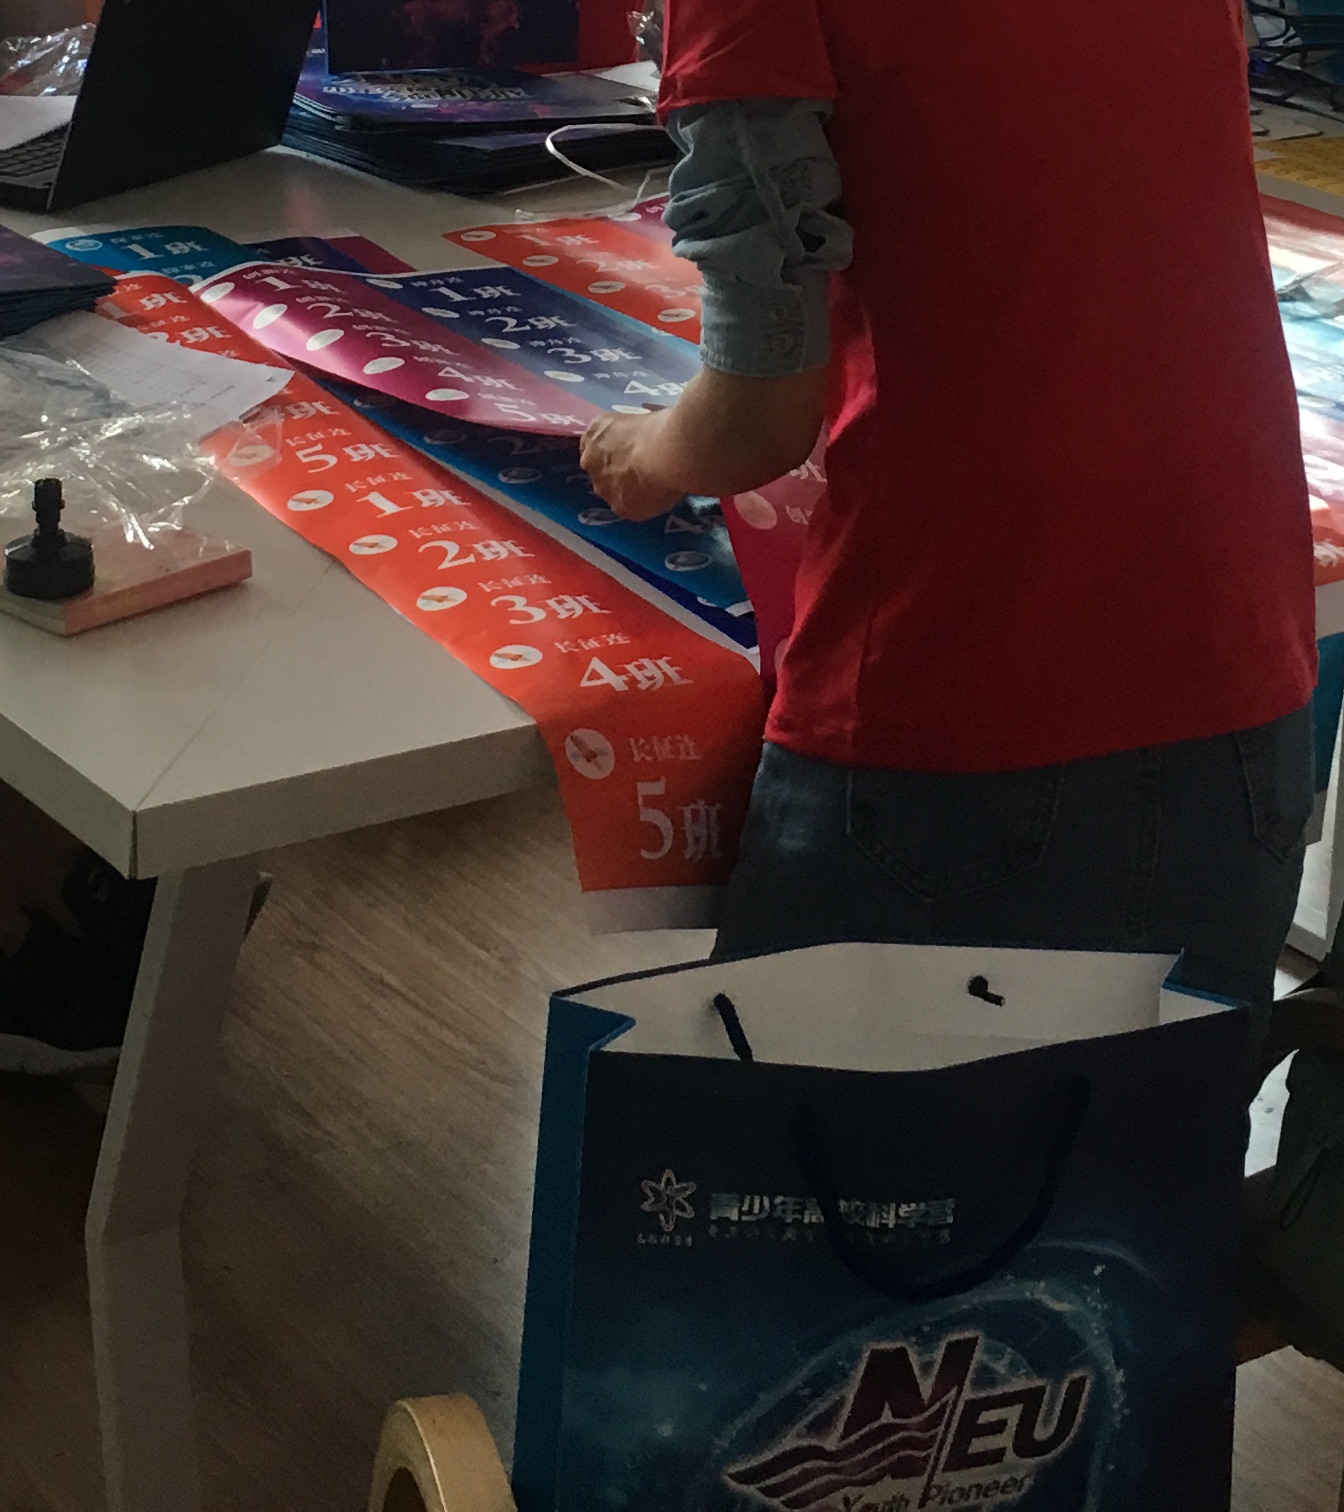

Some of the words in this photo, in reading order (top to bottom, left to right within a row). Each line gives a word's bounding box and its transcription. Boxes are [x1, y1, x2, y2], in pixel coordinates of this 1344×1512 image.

[124, 239, 210, 261] 1班
[429, 285, 522, 303] 1班
[305, 303, 405, 324] 2班
[484, 314, 578, 333] 2班
[547, 345, 643, 364] 3班
[494, 401, 588, 427] 5班
[295, 442, 402, 474] 5班
[355, 488, 472, 519] 1班
[417, 539, 537, 571] 2班
[477, 573, 553, 593] 长征连
[490, 593, 612, 625] 3班
[553, 632, 631, 654] 长征连
[579, 656, 694, 692] 4班
[629, 734, 703, 763] 长征连
[635, 775, 725, 864] 5班
[786, 1336, 1089, 1488] NEU
[926, 1474, 1031, 1508] Pioneer
